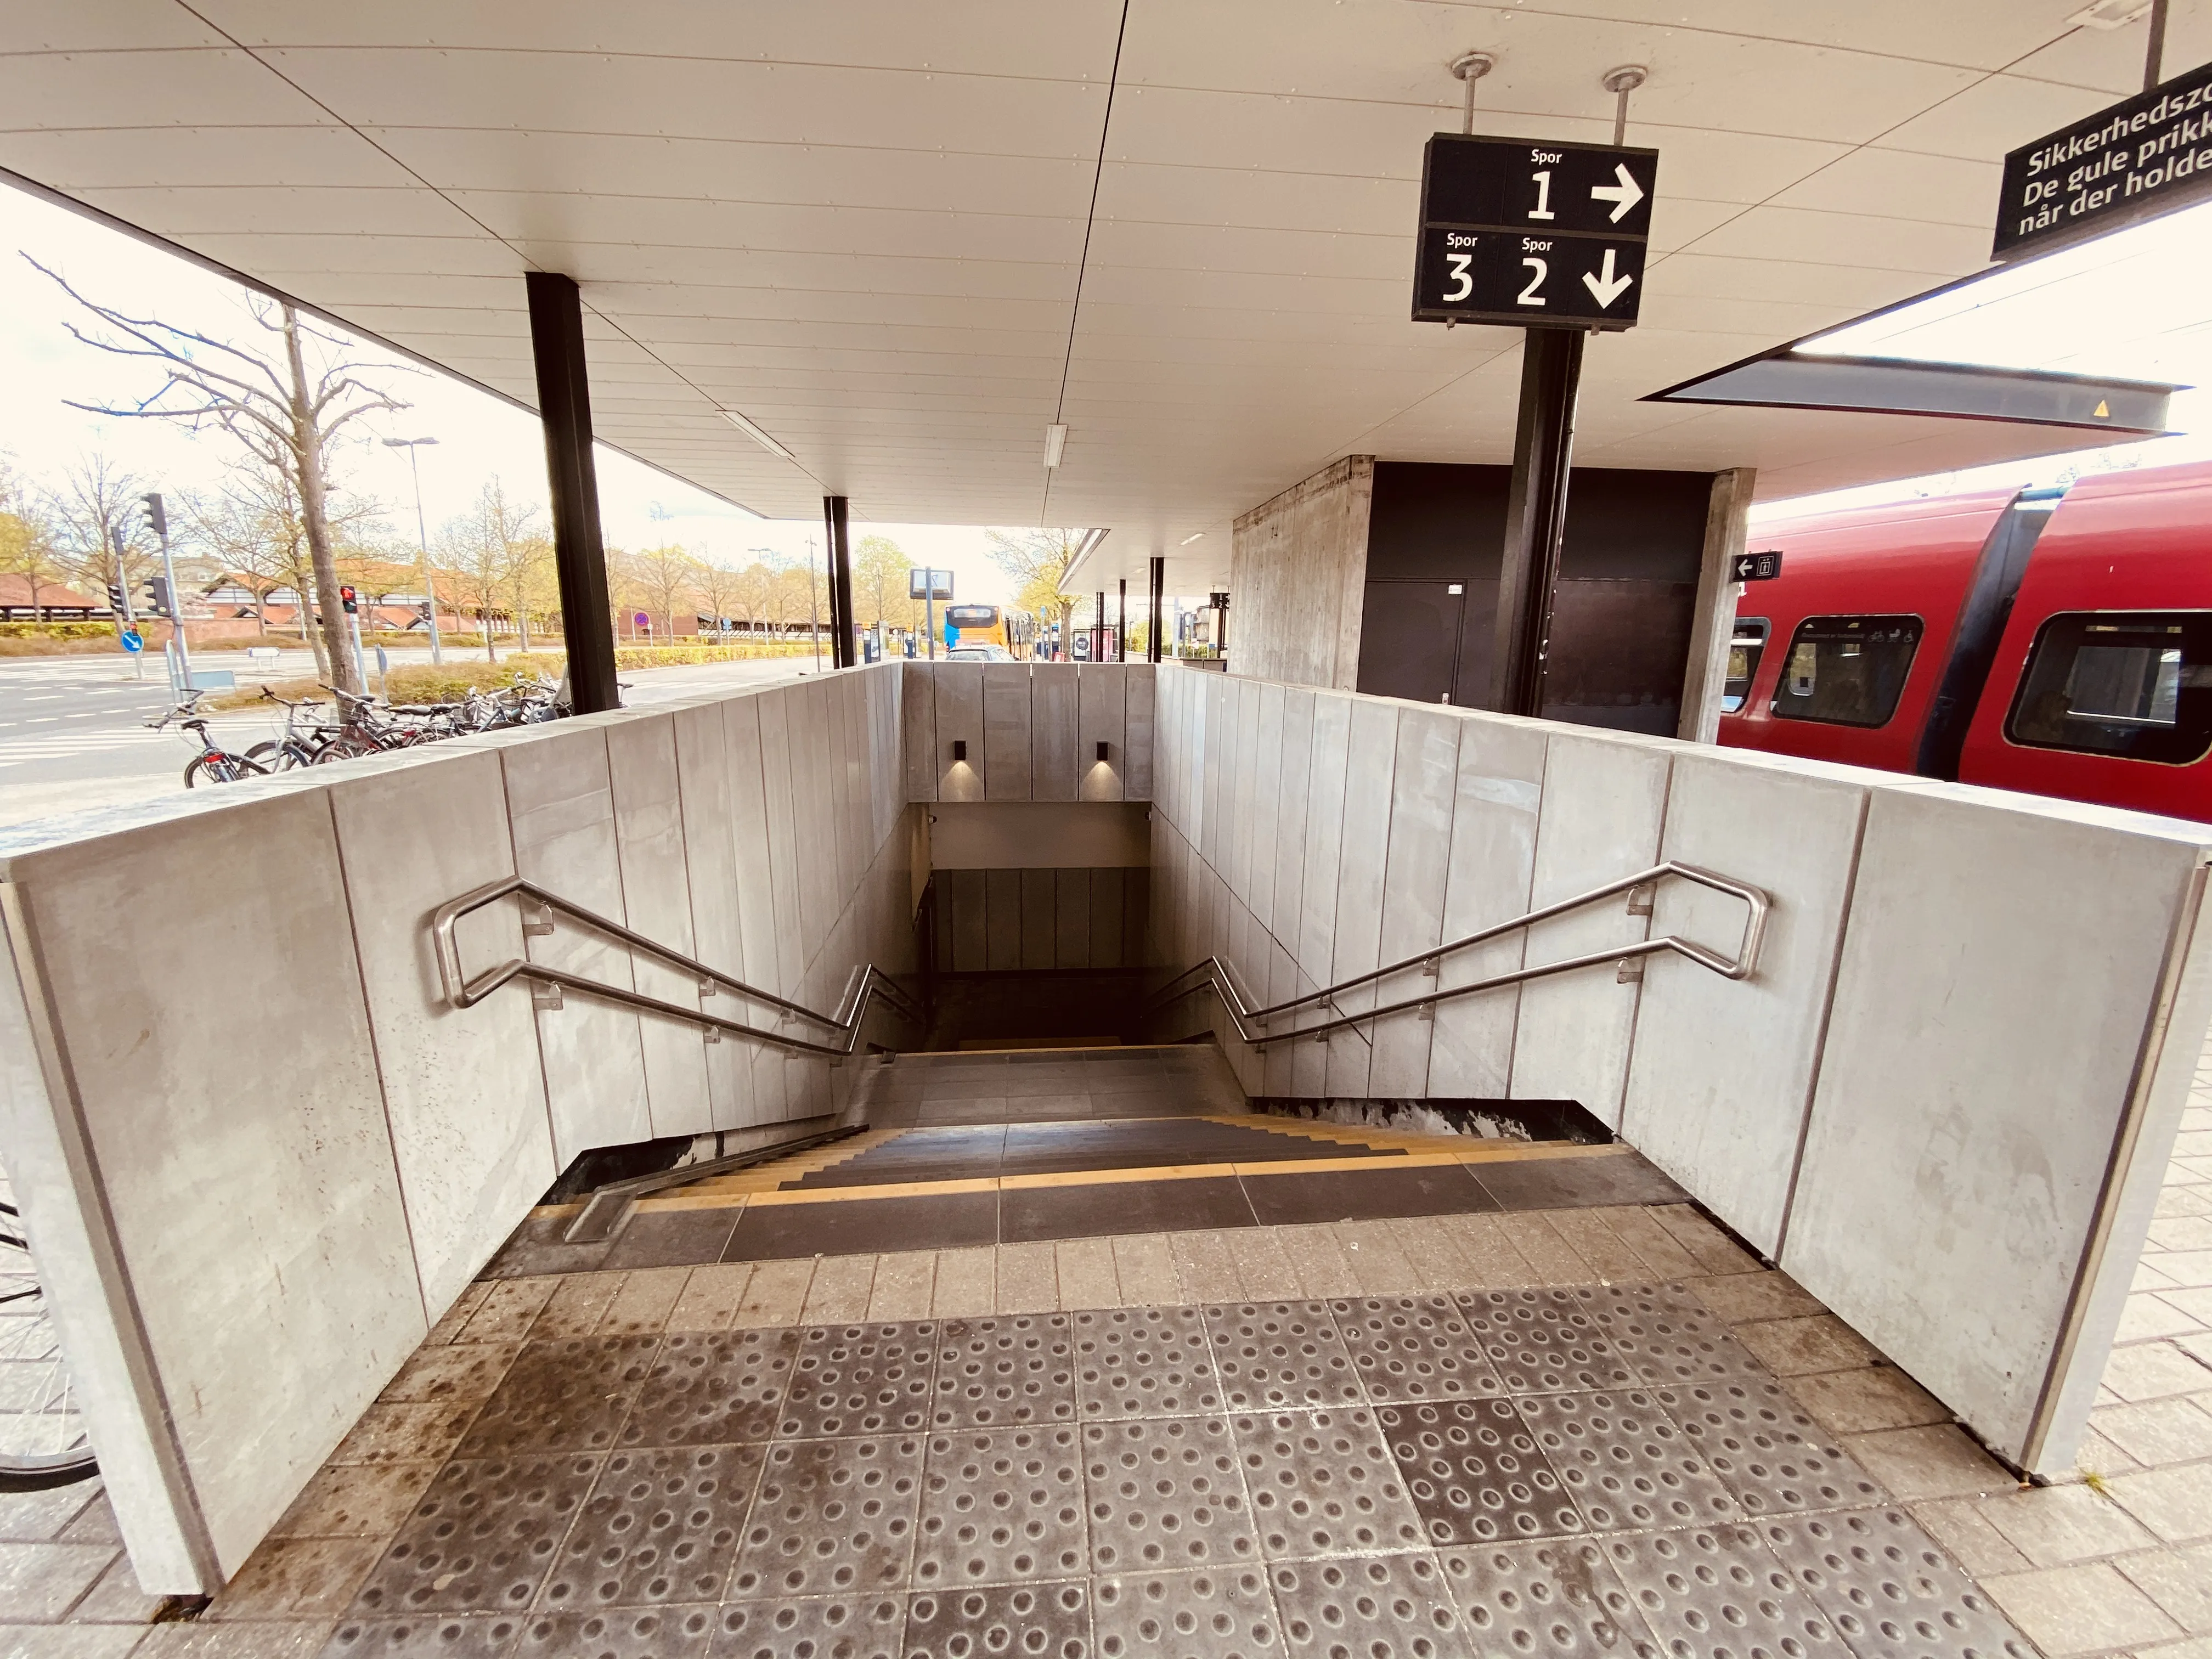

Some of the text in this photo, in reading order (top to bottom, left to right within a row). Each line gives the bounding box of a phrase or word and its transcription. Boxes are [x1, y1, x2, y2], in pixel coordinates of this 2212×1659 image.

[1531, 149, 1562, 166] Spor
[2023, 180, 2058, 207] De
[2067, 150, 2129, 192] gule
[1528, 171, 1555, 220] 1
[2019, 148, 2212, 235] når der holde
[1447, 233, 1553, 253] Spor Spor
[1442, 253, 1548, 306] 3 2
